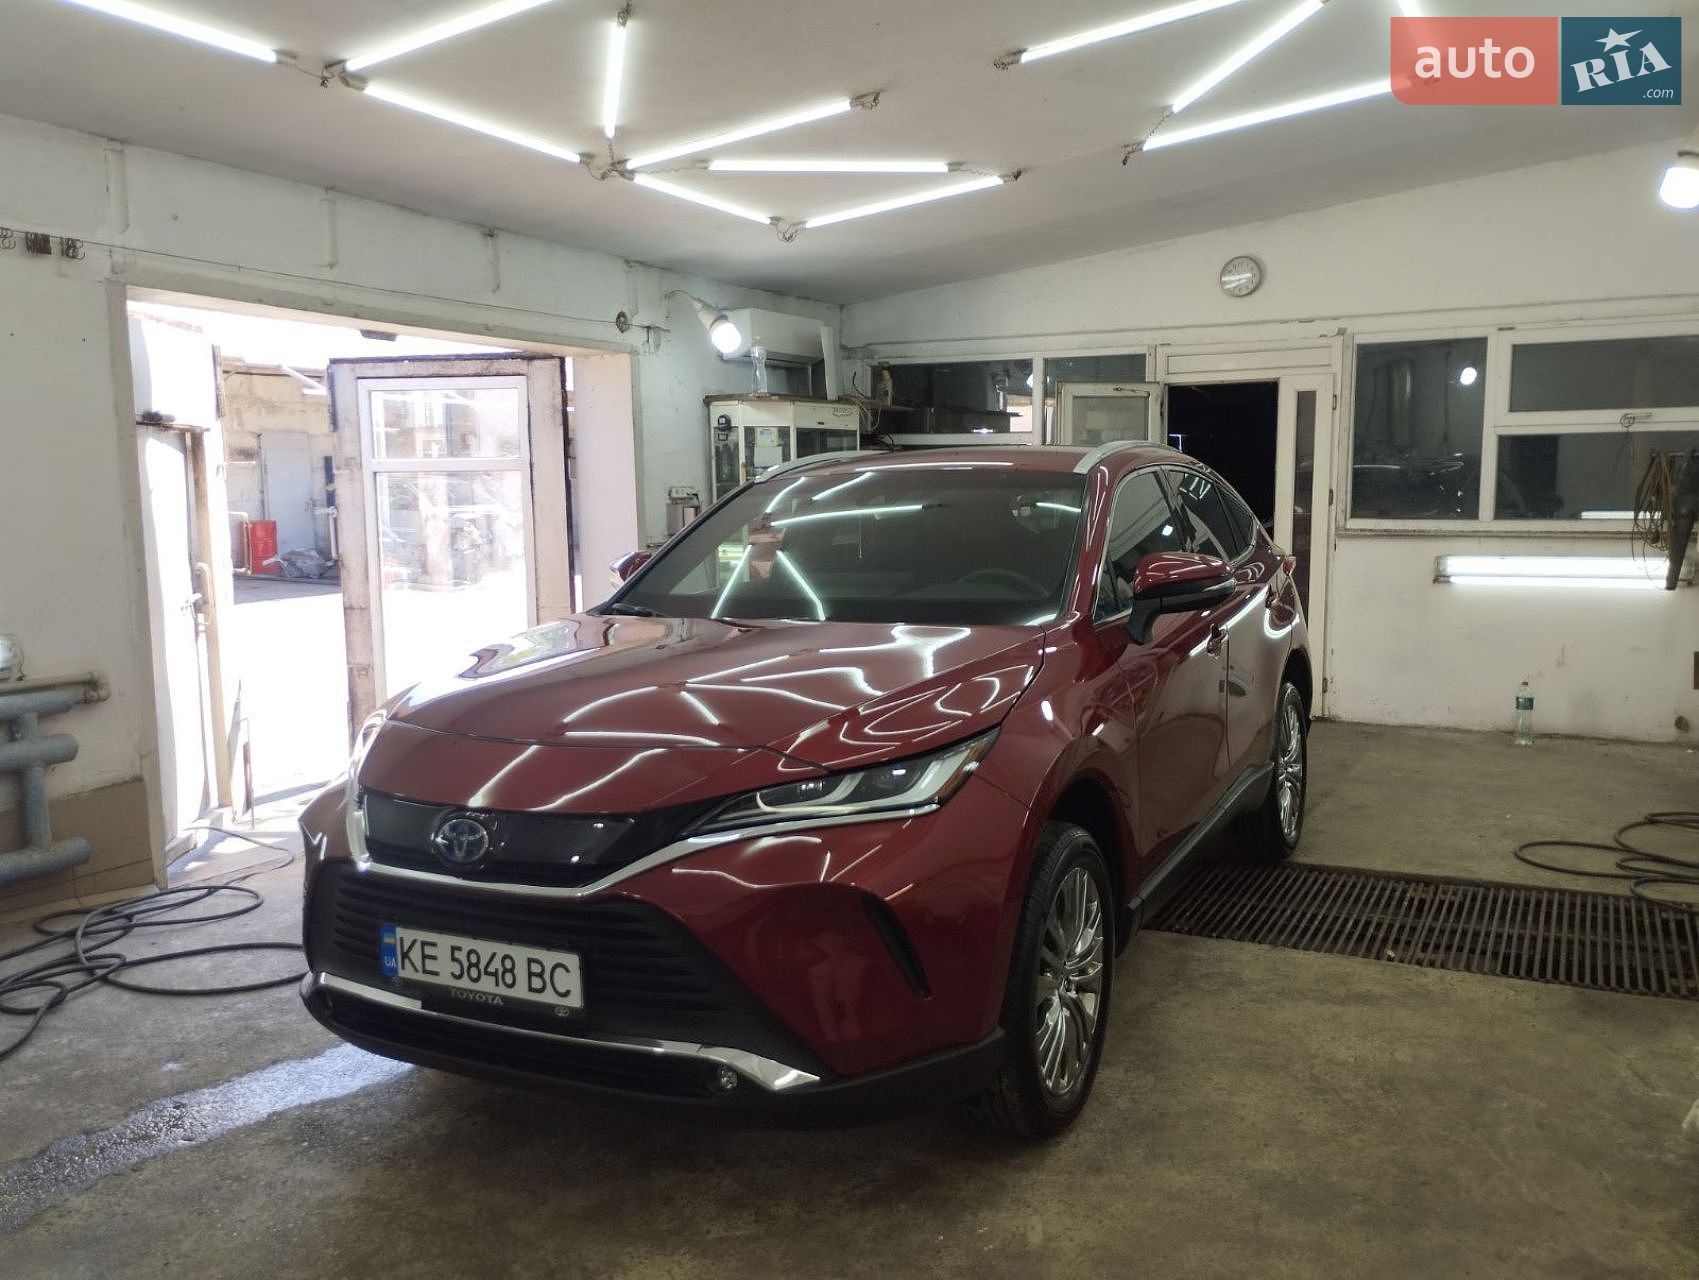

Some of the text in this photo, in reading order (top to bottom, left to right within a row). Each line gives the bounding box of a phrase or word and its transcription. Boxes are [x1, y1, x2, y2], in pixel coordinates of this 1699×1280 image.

[384, 955, 397, 968] UA
[399, 936, 572, 999] KE 5848 BC
[450, 988, 504, 1006] TOYOTA
